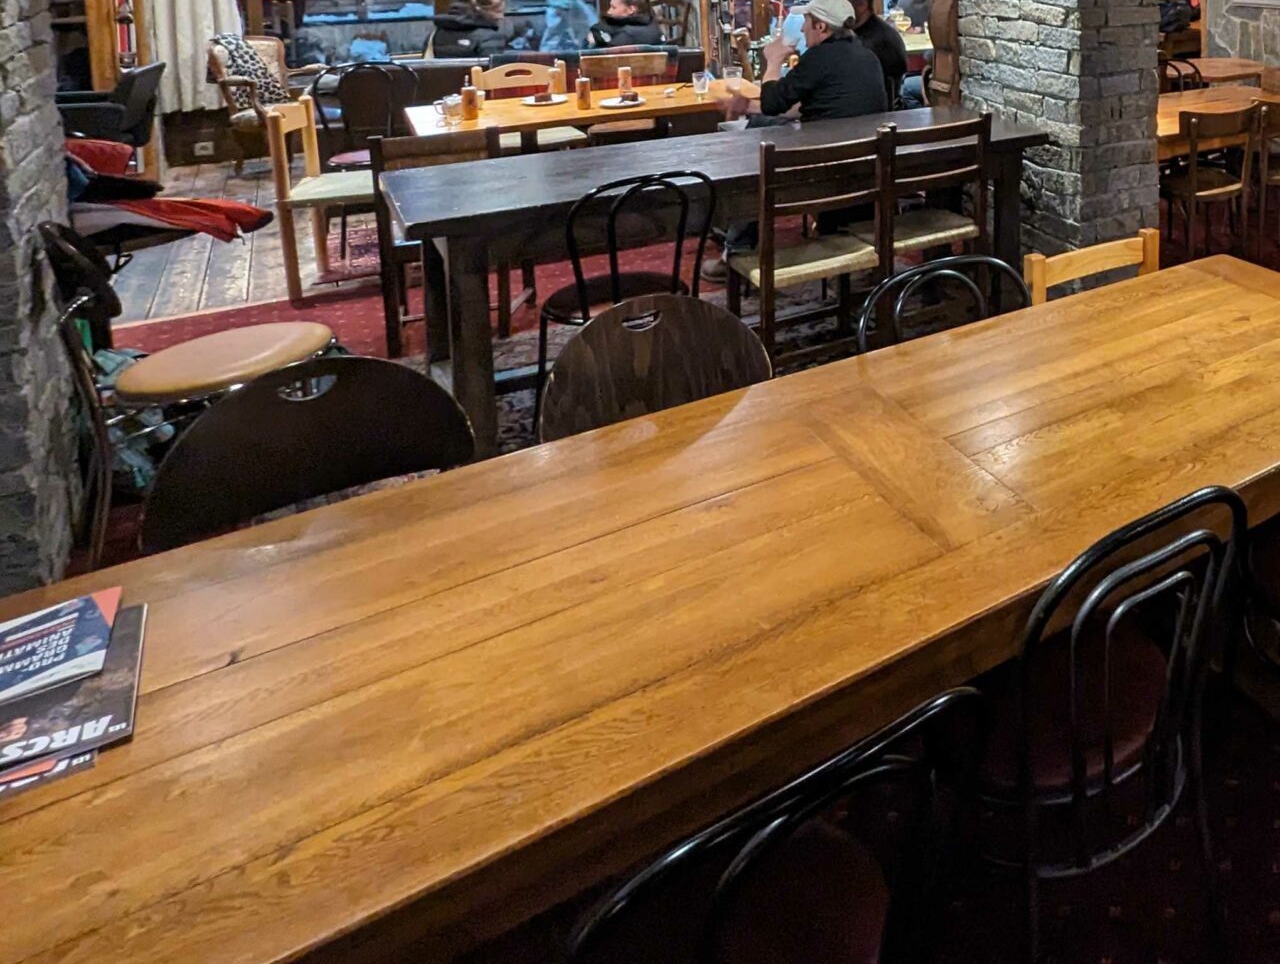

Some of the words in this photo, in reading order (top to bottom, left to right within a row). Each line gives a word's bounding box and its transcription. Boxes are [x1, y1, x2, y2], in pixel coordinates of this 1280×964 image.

[36, 636, 70, 654] DES
[20, 652, 65, 672] PRO-
[108, 722, 127, 733] LES
[0, 714, 113, 763] ARCS
[71, 753, 91, 766] LES
